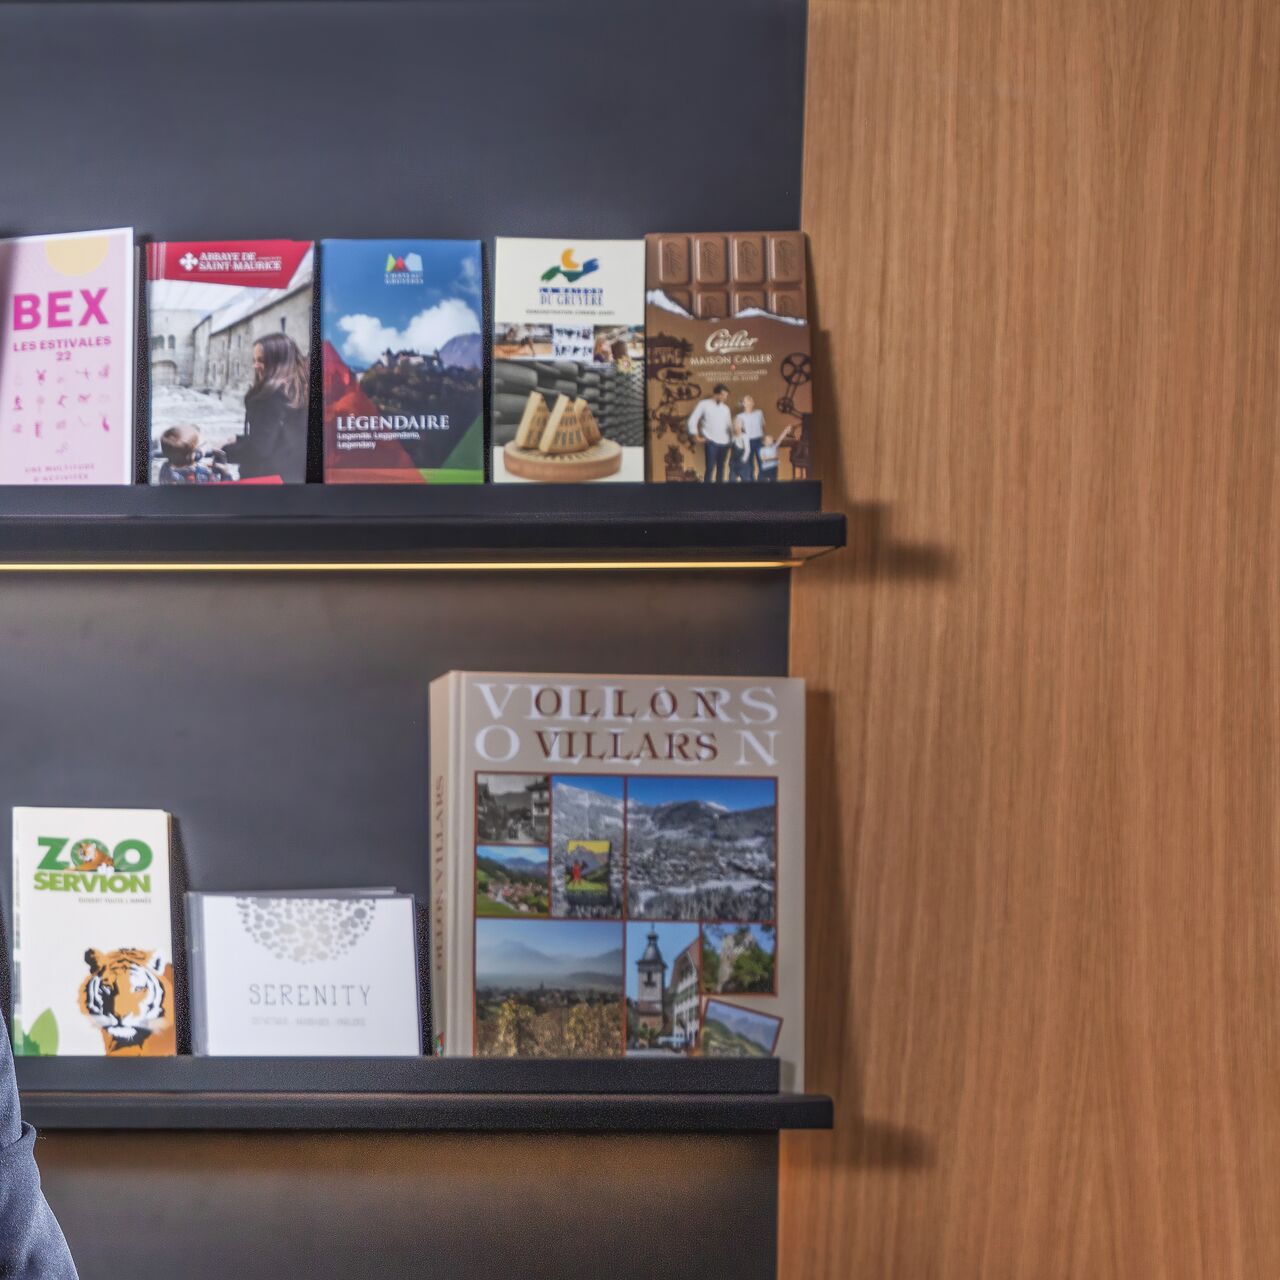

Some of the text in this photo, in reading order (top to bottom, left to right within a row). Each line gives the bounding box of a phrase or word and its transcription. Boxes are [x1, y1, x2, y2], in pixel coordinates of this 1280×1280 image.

[241, 251, 257, 261] DE
[12, 287, 110, 331] BEX
[13, 336, 112, 353] LES ESTIVALES
[704, 329, 759, 353] Cailler
[56, 351, 72, 361] 22
[689, 354, 730, 366] MAISON
[336, 413, 450, 431] LÉGENDAIRE
[535, 730, 721, 762] VILLARS
[36, 837, 154, 873] ZOO
[33, 872, 153, 894] SERVION
[248, 983, 371, 1007] SERENITY
